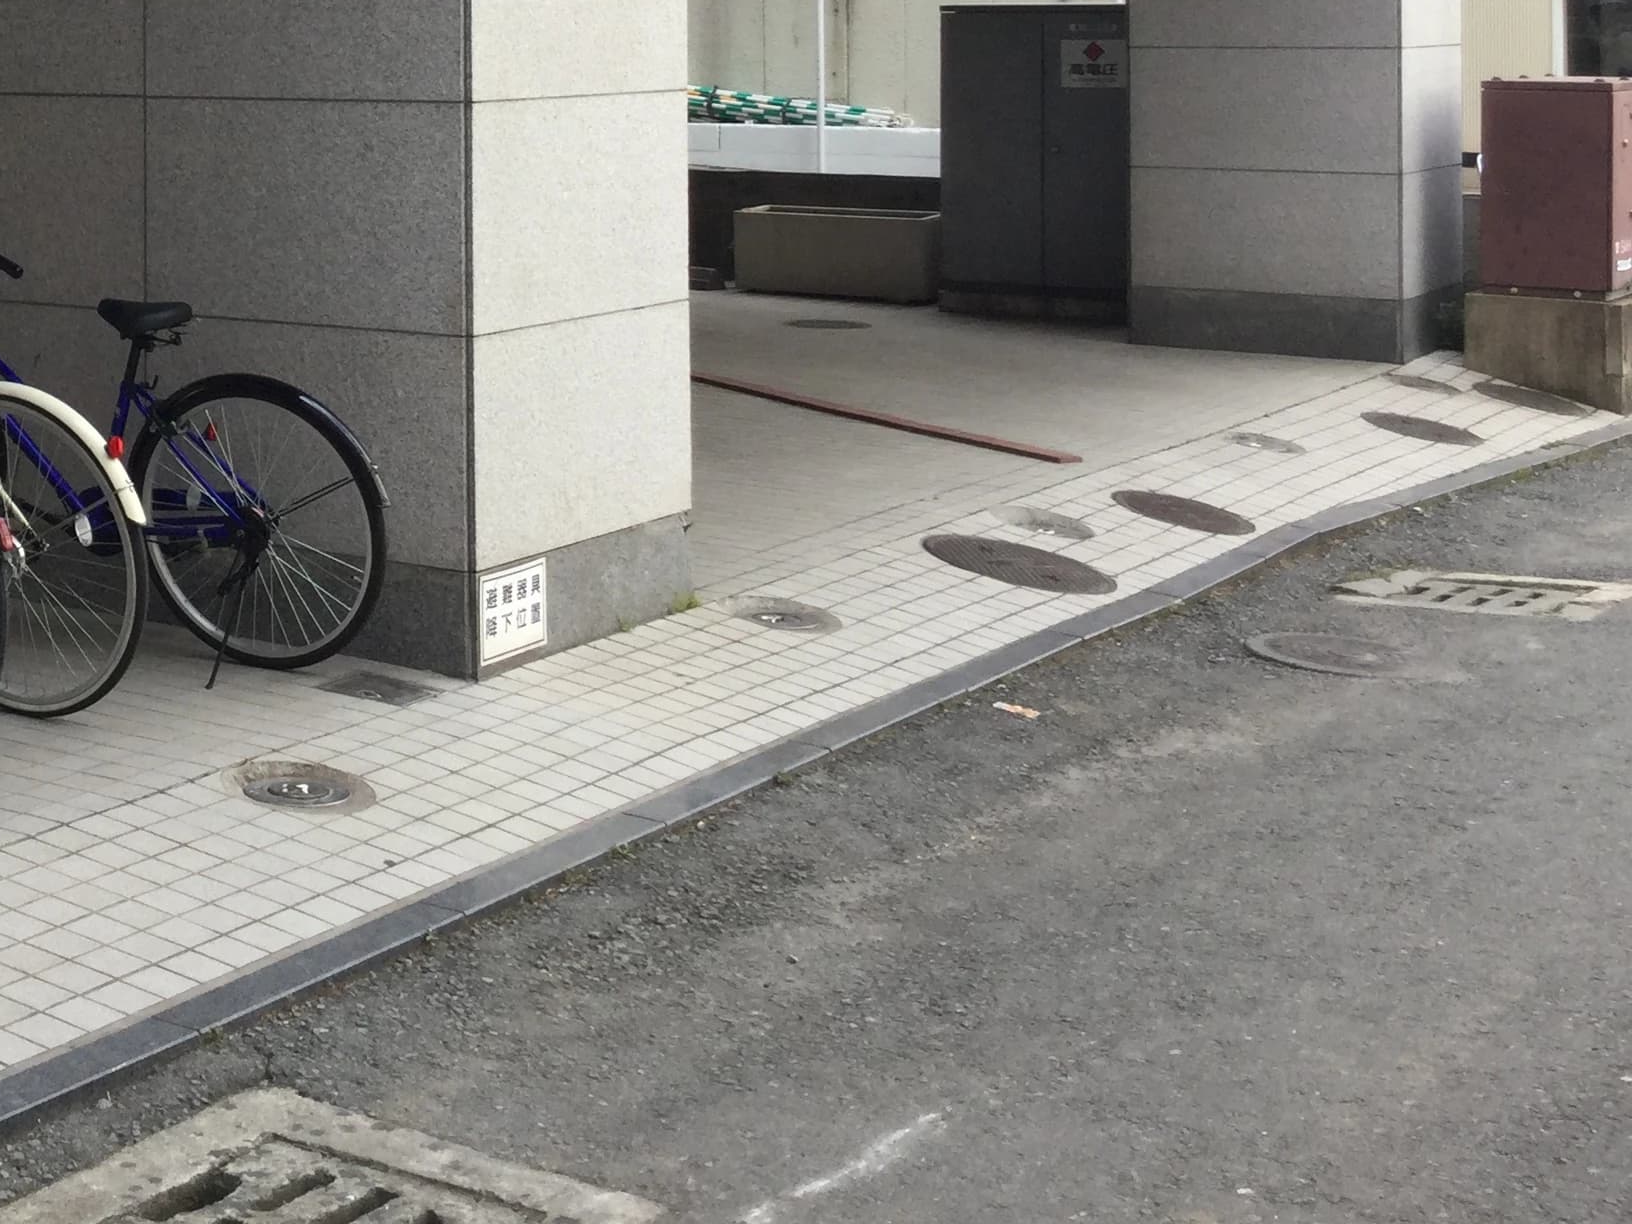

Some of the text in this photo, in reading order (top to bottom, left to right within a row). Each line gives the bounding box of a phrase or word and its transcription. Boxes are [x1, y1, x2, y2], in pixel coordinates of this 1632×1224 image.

[486, 574, 540, 609] 避難器具
[486, 602, 540, 638] 降下位置
